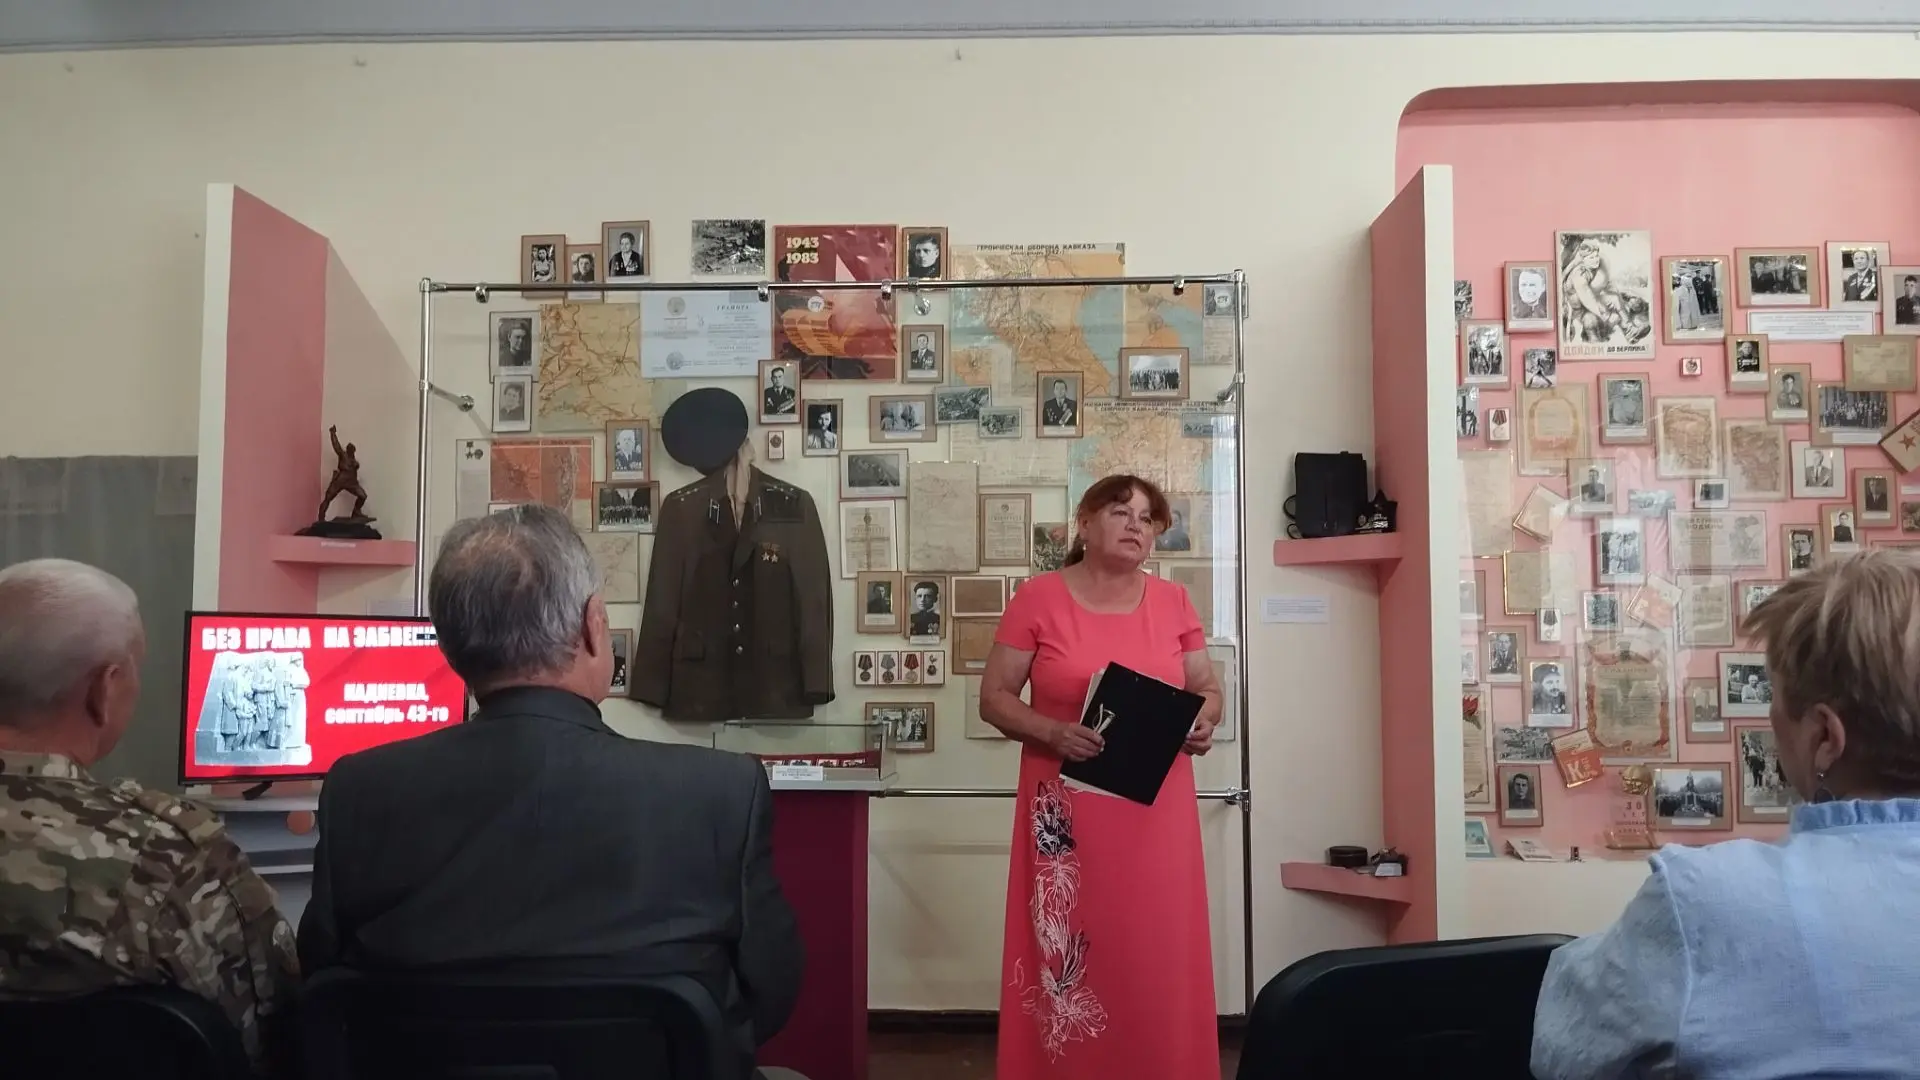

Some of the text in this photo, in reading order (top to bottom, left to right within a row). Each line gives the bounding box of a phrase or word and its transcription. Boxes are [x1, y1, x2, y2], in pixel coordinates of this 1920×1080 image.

[786, 236, 819, 249] 1943
[786, 252, 819, 264] 1983
[202, 626, 438, 650] БЕЗ ПРАВА НА ЗАБВЕНИ
[325, 704, 449, 724] сентябрь 43-го
